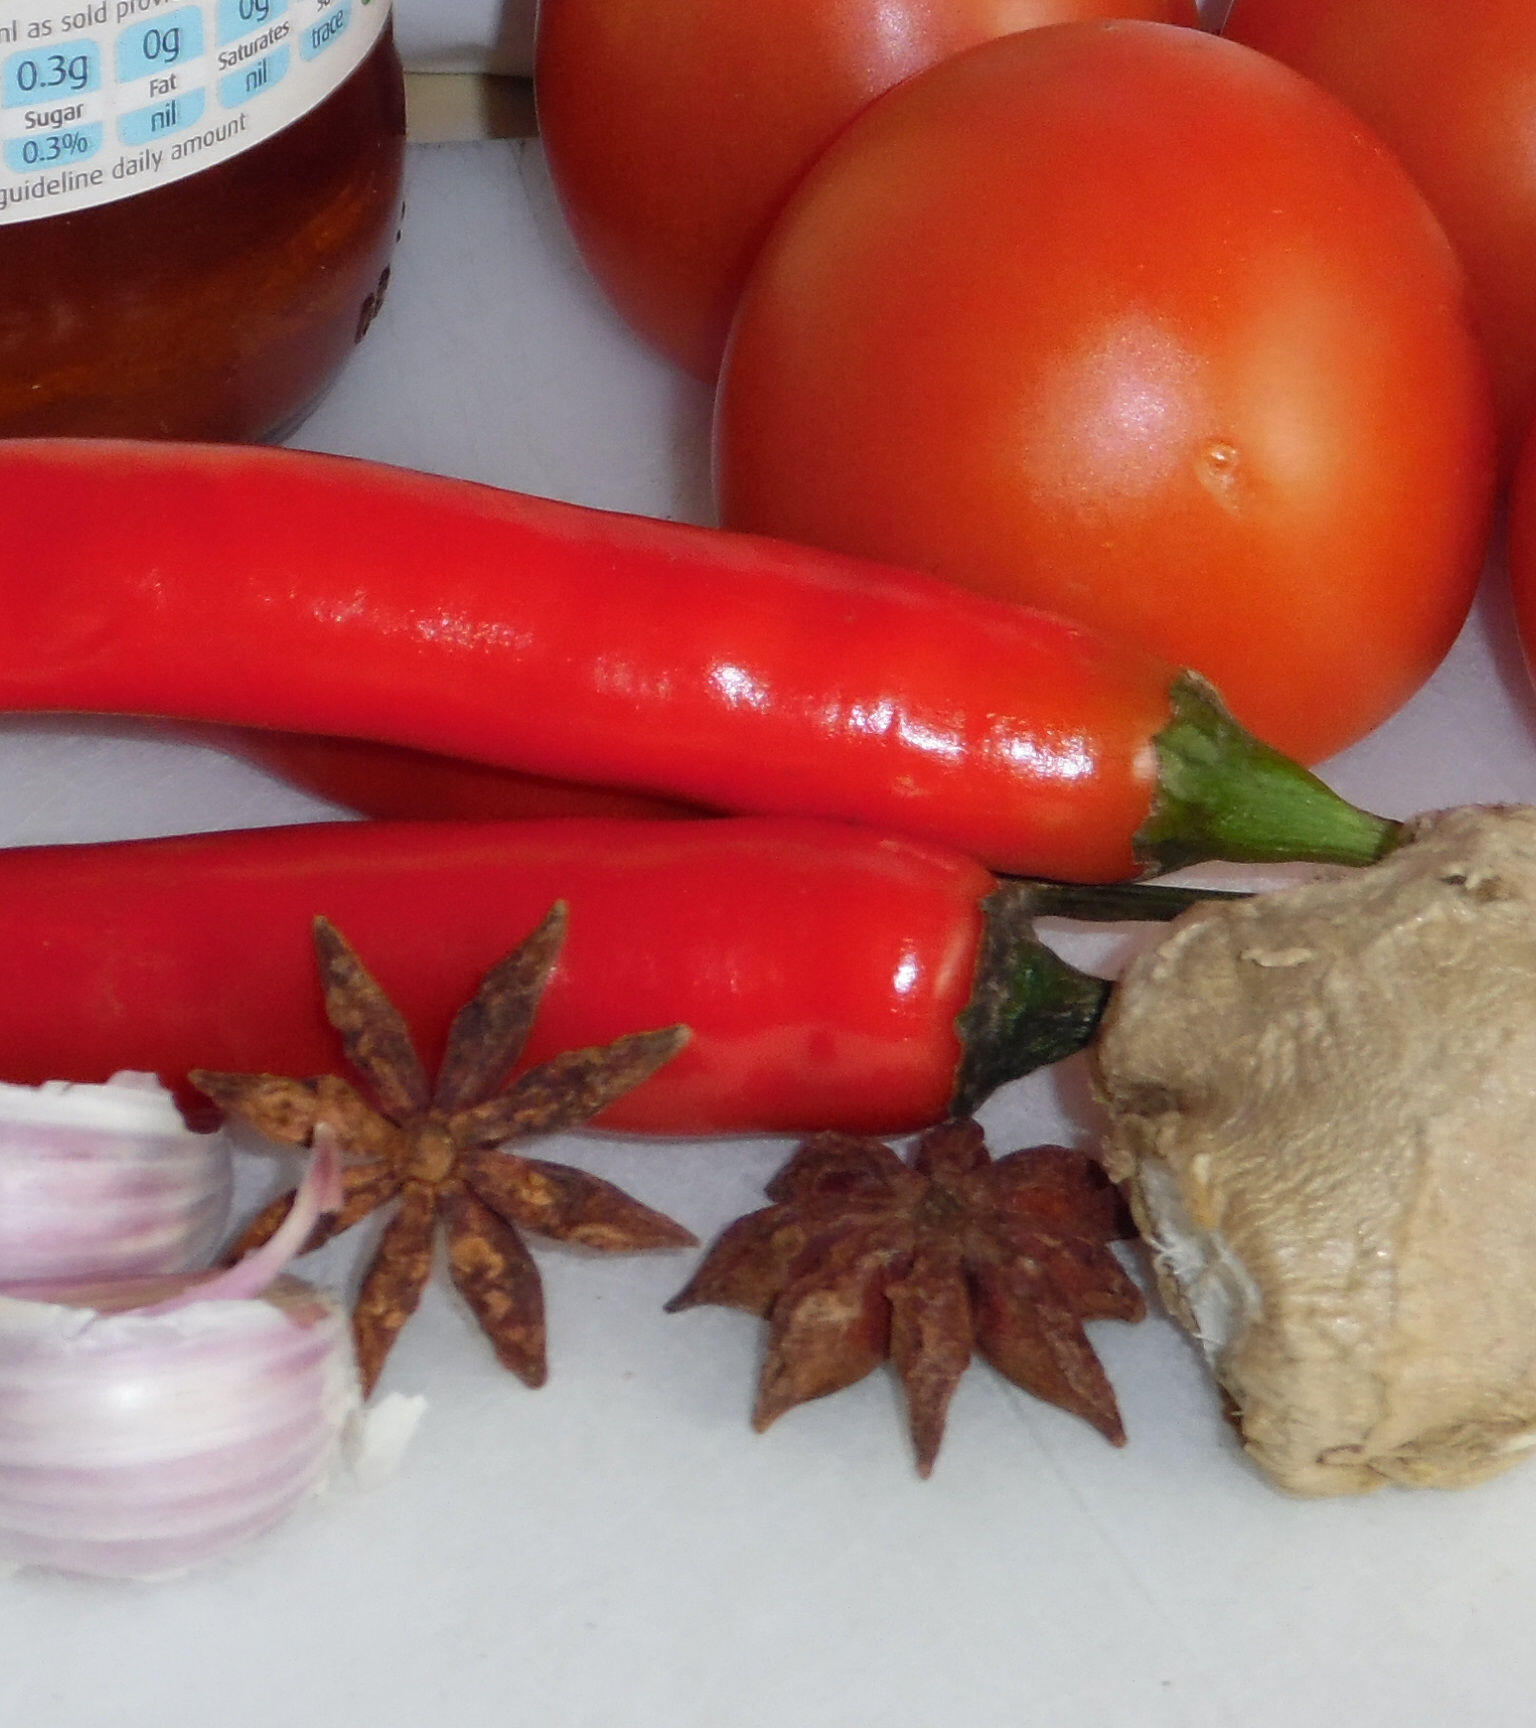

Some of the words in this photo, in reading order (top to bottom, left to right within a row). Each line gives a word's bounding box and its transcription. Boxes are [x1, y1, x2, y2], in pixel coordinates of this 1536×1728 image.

[26, 18, 53, 40] as
[61, 0, 108, 33] sold
[17, 54, 89, 92] 0.3g
[143, 27, 180, 63] 0g
[22, 131, 89, 165] 0.3%
[150, 99, 177, 132] nil
[245, 58, 268, 92] nil
[311, 9, 344, 49] trace
[24, 102, 85, 130] Sugar
[149, 72, 178, 98] Fat
[217, 20, 291, 72] Saturates
[111, 147, 164, 180] daily
[170, 111, 249, 161] amount
